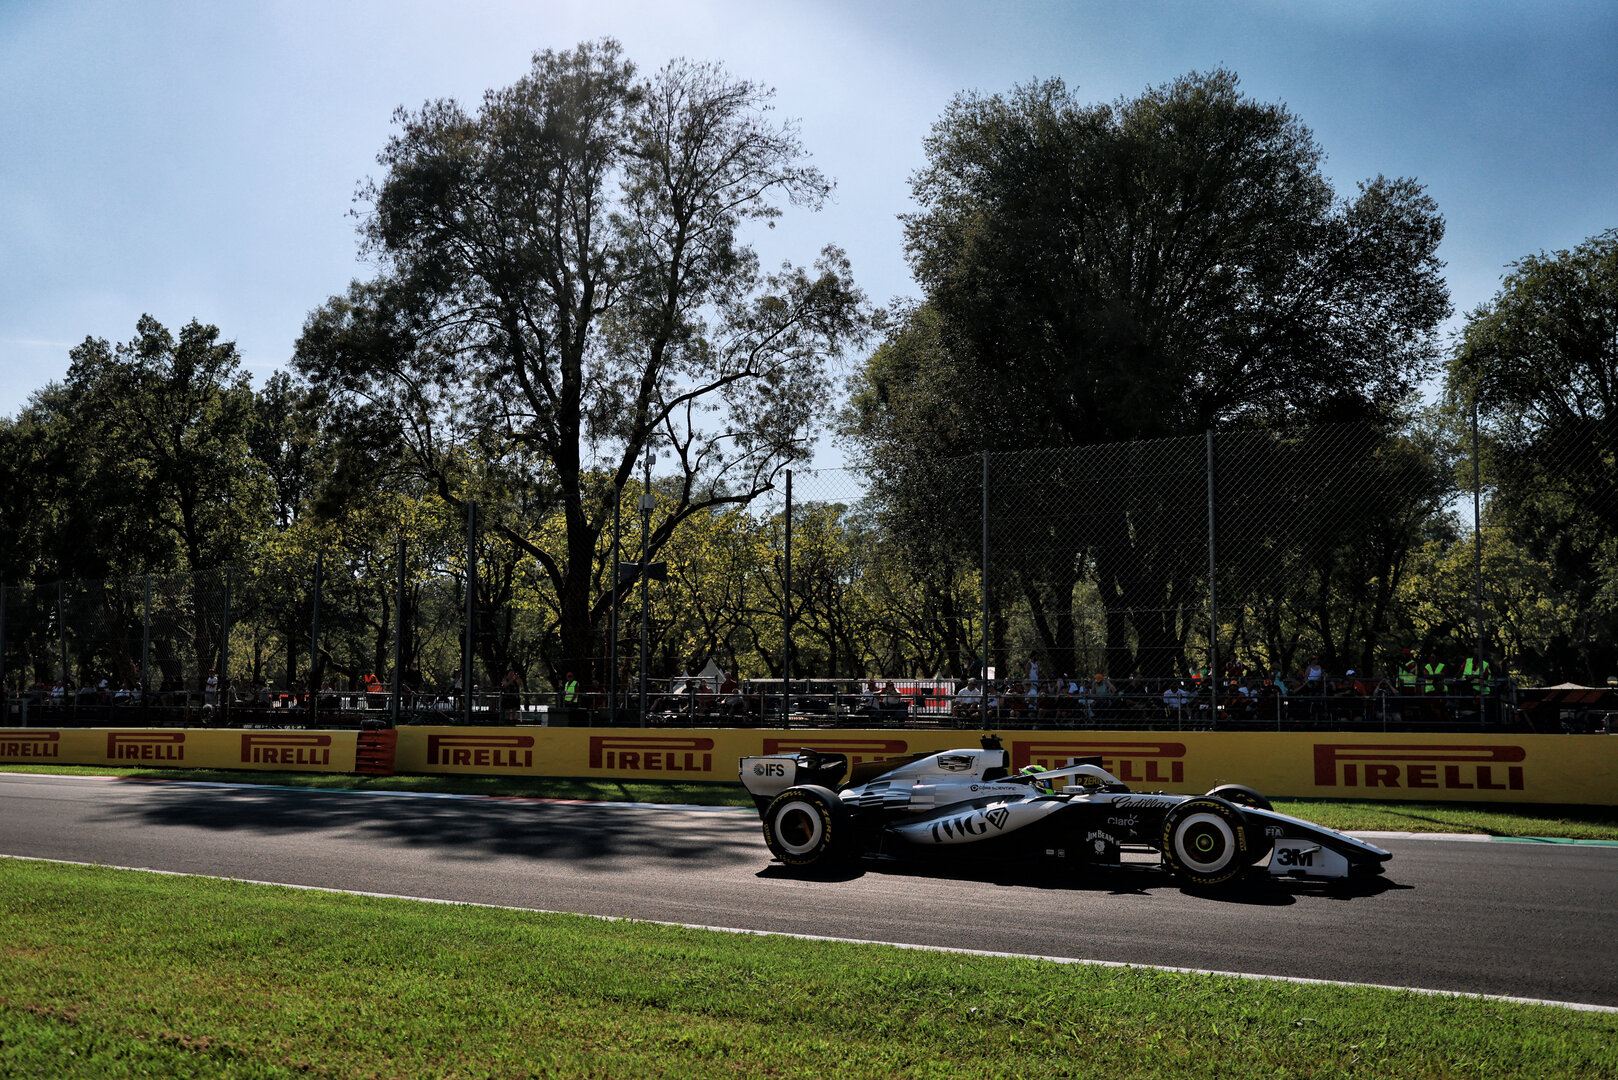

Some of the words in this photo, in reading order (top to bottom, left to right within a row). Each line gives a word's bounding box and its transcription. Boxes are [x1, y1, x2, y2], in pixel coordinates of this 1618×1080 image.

[107, 733, 186, 760] PIRELLI
[241, 734, 331, 765] PIRELLI
[427, 734, 535, 767] PIRELLI
[589, 736, 714, 771] PIRELLI
[765, 763, 785, 776] IFS
[1012, 741, 1187, 783] PLLI
[1313, 744, 1526, 790] PIRELLI
[1111, 796, 1172, 809] Cadillac
[926, 812, 987, 842] TWG
[1107, 815, 1135, 826] Claro
[1265, 827, 1282, 837] FIA
[1085, 831, 1097, 842] JIM
[1277, 848, 1312, 866] 3M
